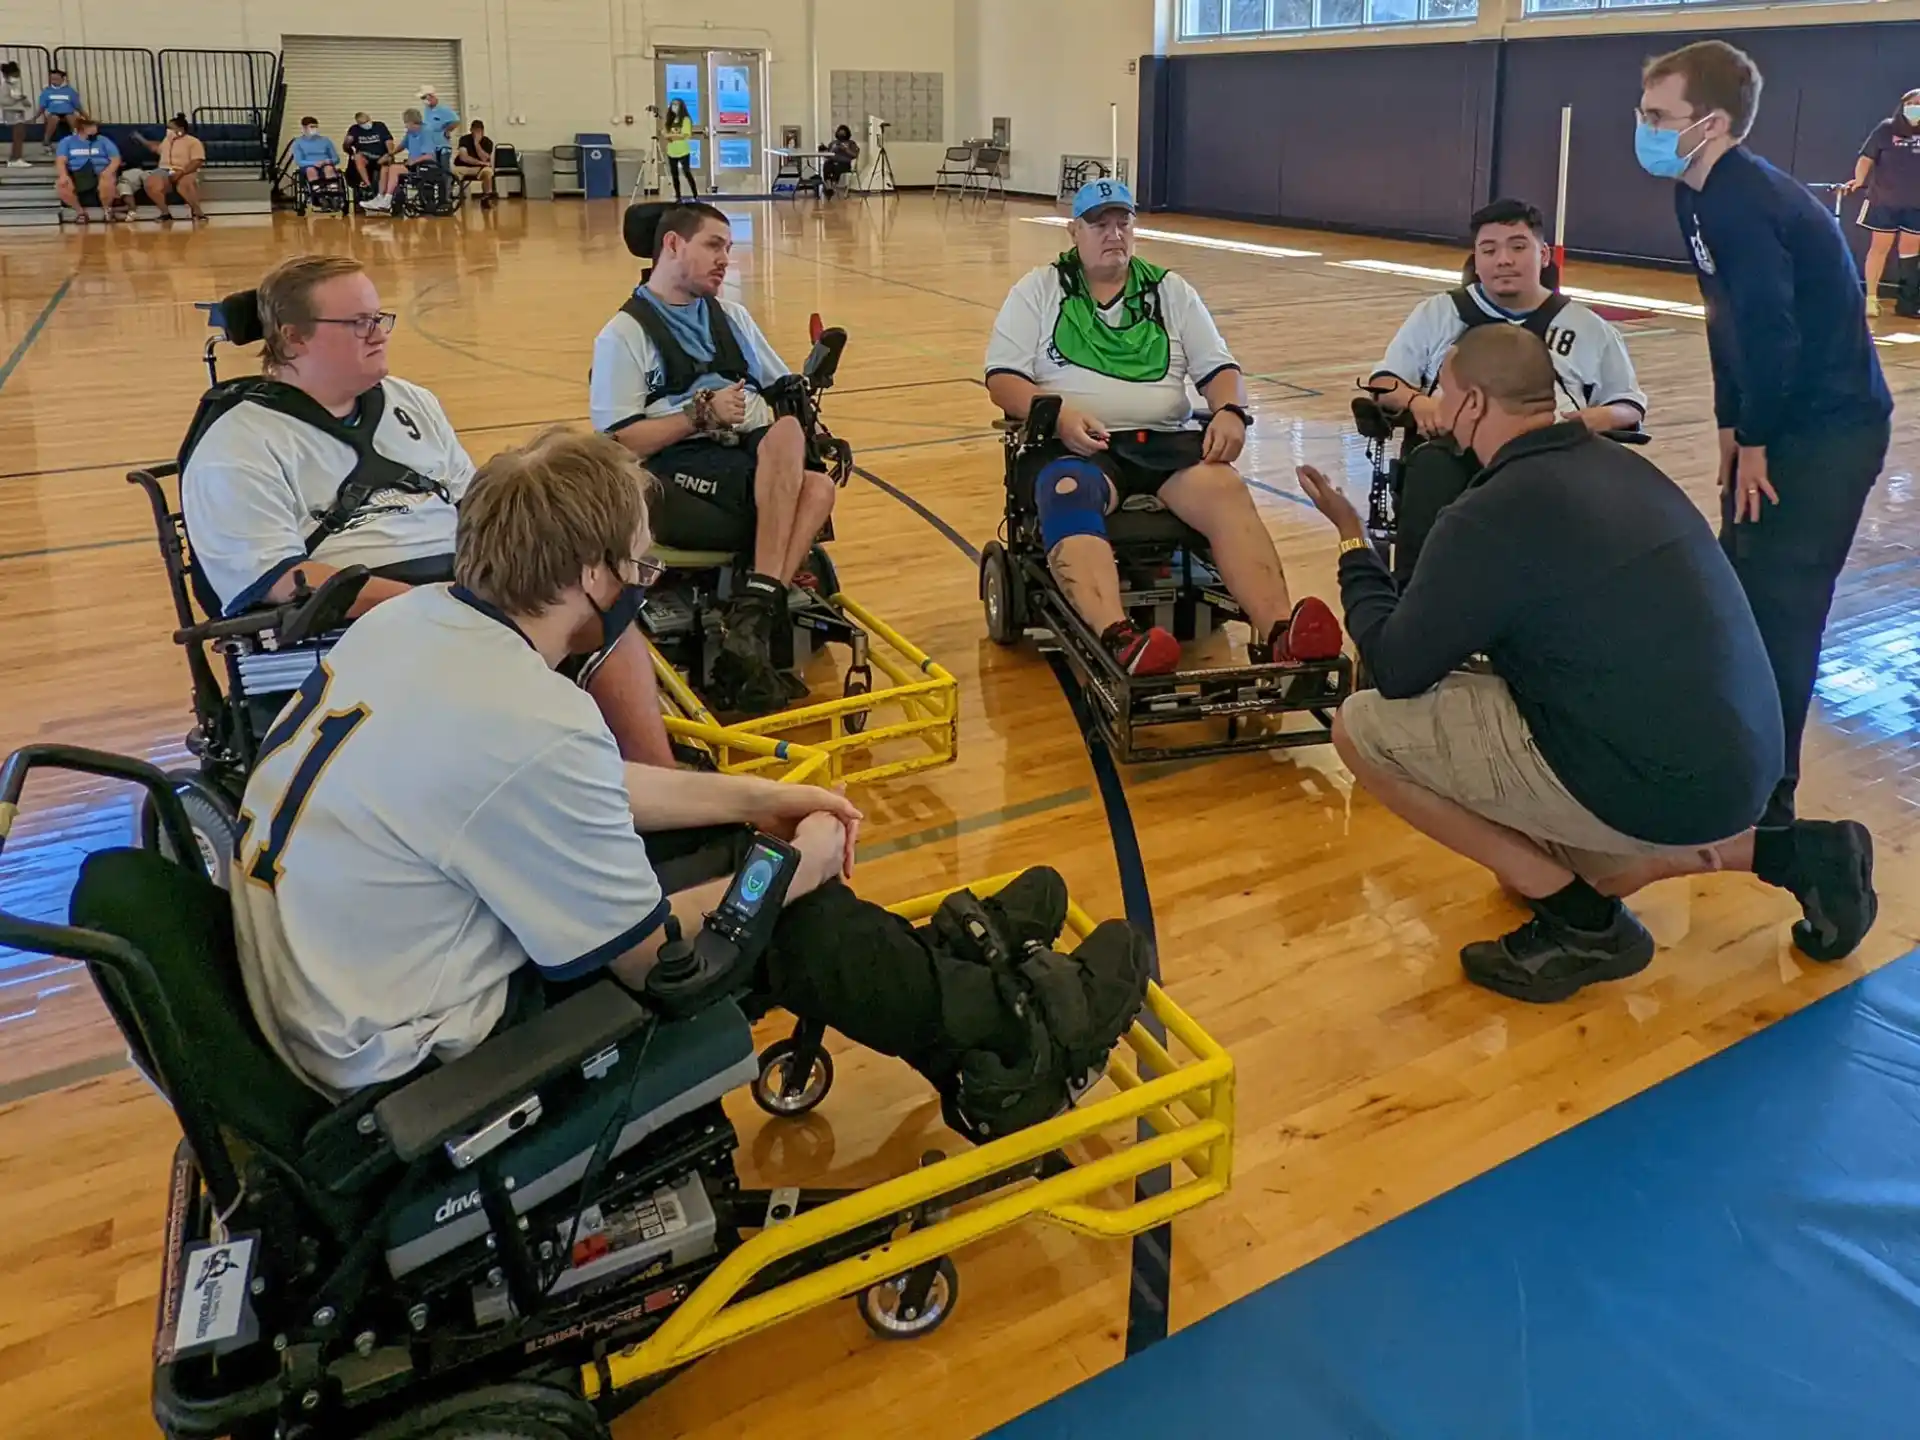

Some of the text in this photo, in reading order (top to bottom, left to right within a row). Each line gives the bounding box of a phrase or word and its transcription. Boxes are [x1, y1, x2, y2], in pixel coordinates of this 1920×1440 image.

[1096, 182, 1113, 198] B
[1548, 326, 1577, 357] 18
[393, 406, 421, 441] 9
